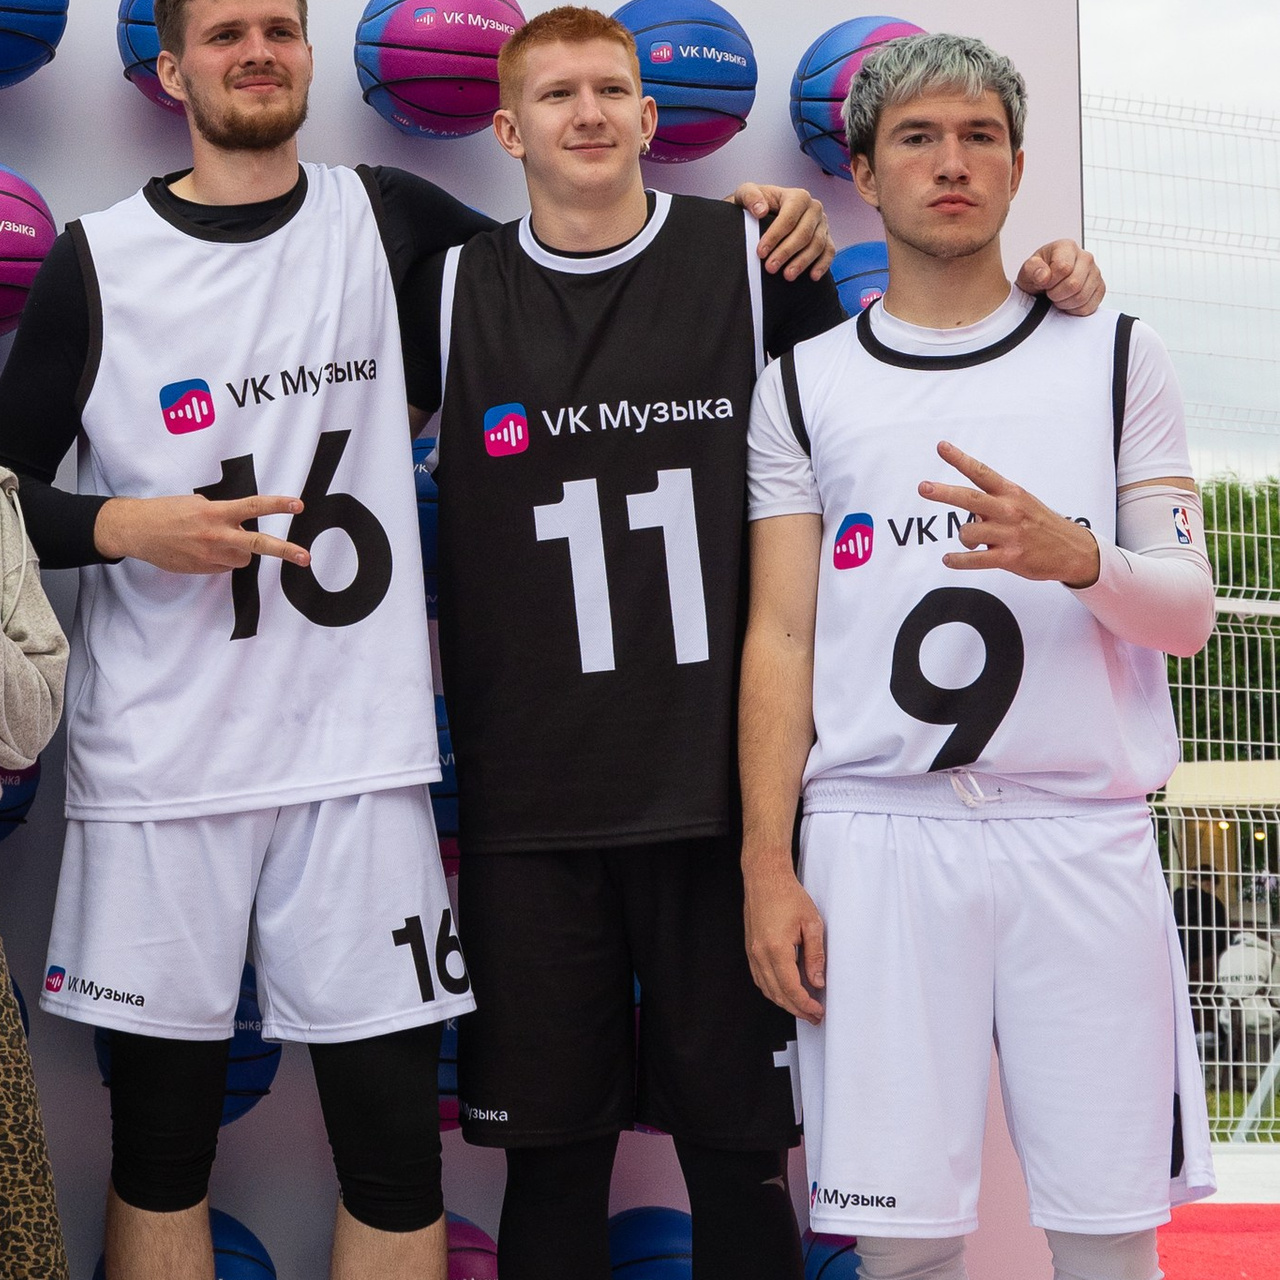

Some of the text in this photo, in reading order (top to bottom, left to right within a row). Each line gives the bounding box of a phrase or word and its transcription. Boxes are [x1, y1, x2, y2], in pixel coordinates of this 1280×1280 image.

[443, 12, 515, 35] VK Музыка
[679, 45, 747, 67] VK Музыка
[225, 355, 378, 410] VK Музыка
[541, 396, 734, 437] VK Музыка
[193, 428, 393, 642] 16
[887, 514, 939, 547] VK
[532, 467, 710, 674] 11
[889, 586, 1026, 774] 9
[391, 907, 470, 1003] 16
[67, 975, 145, 1007] VK Музыка
[823, 1188, 897, 1209] Музыка
